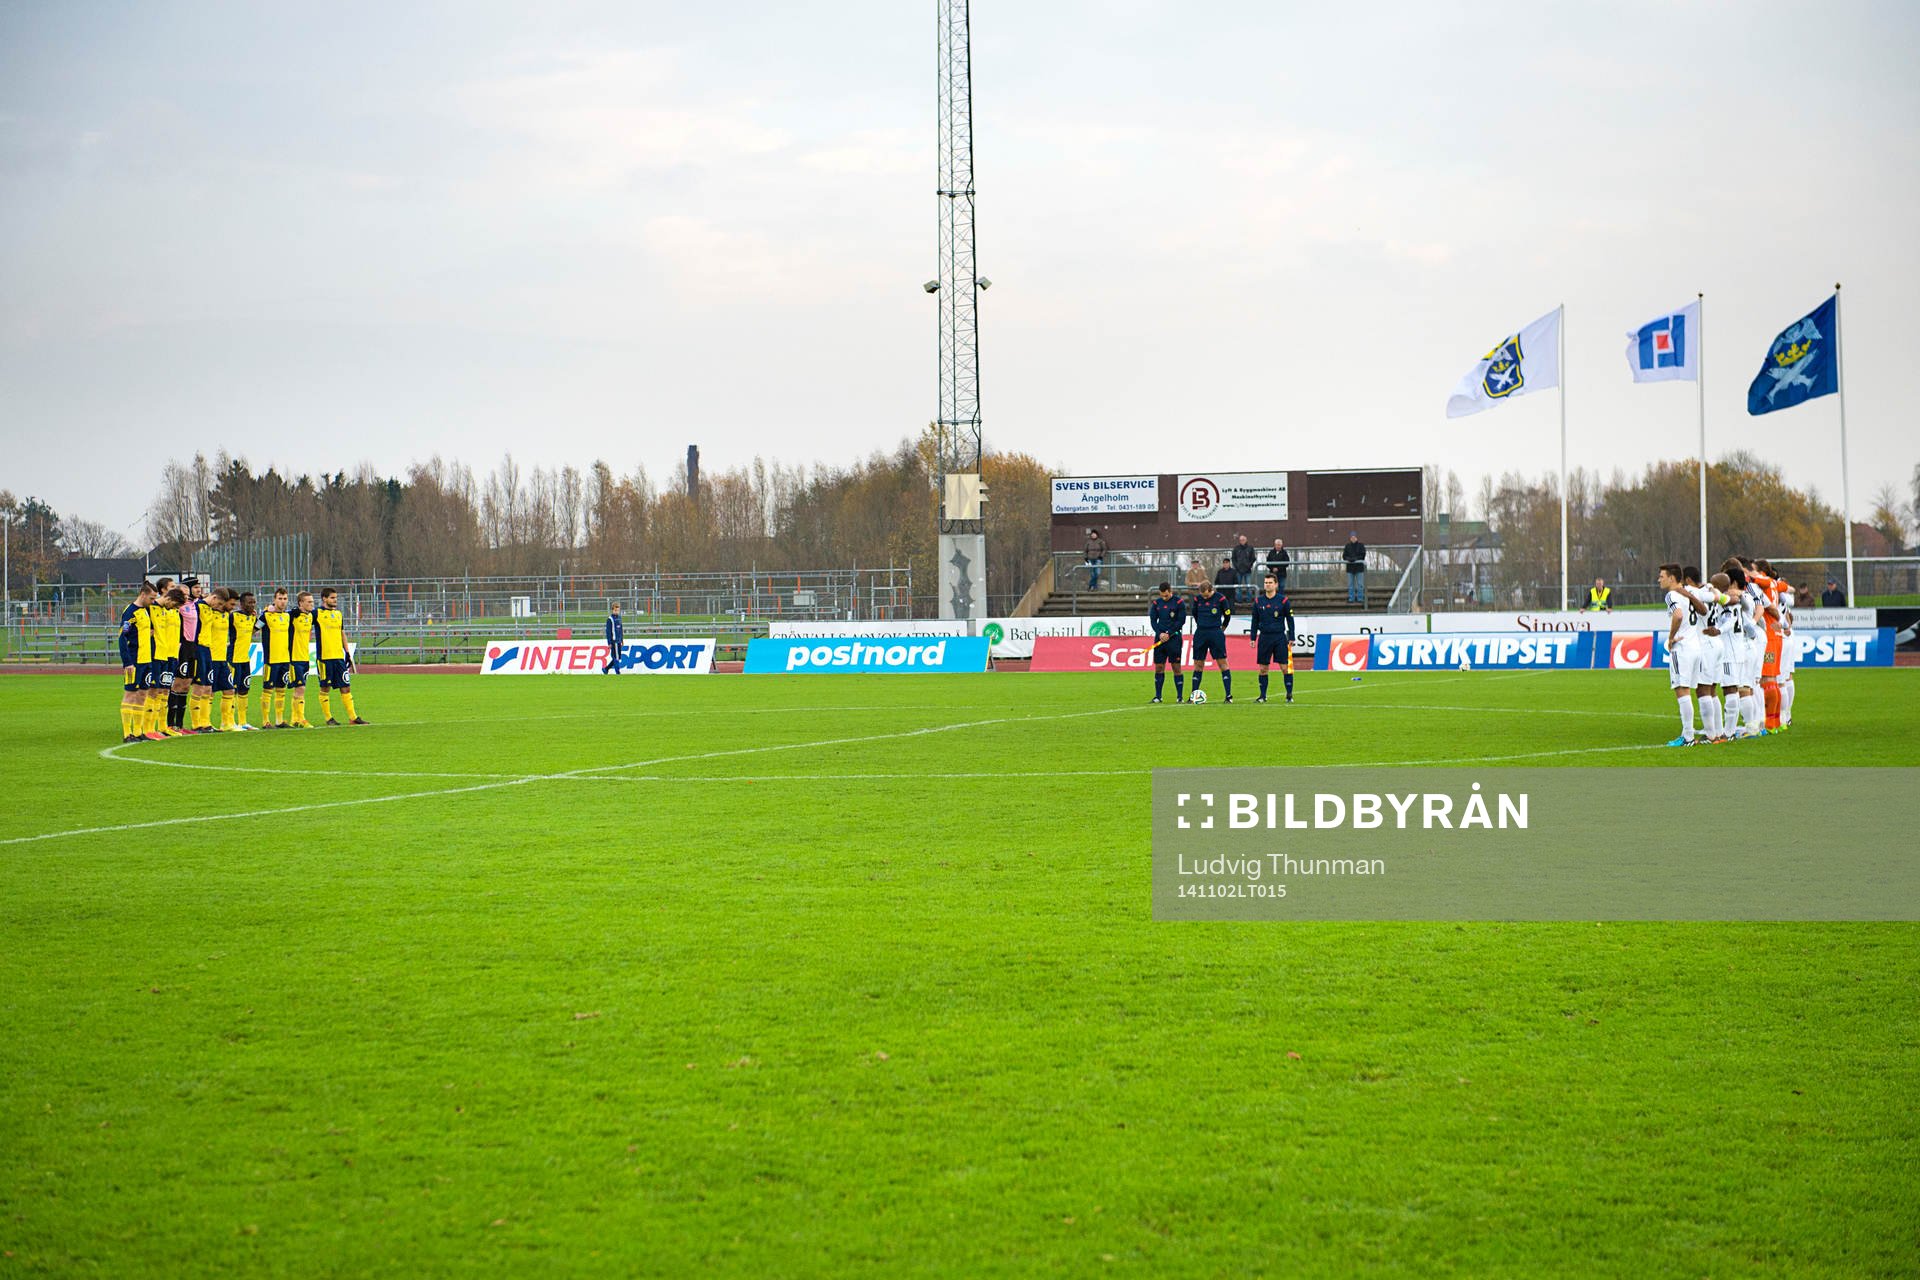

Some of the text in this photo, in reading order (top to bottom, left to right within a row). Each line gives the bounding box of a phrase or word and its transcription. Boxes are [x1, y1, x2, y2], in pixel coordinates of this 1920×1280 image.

[1055, 480, 1155, 491] SVENS BILSERVICE
[1081, 493, 1129, 504] Ängelholm
[1055, 504, 1090, 513] Östergatan
[520, 644, 705, 670] INTERSPORT
[786, 640, 947, 671] postnord
[1377, 638, 1572, 665] STRYKTIPSET
